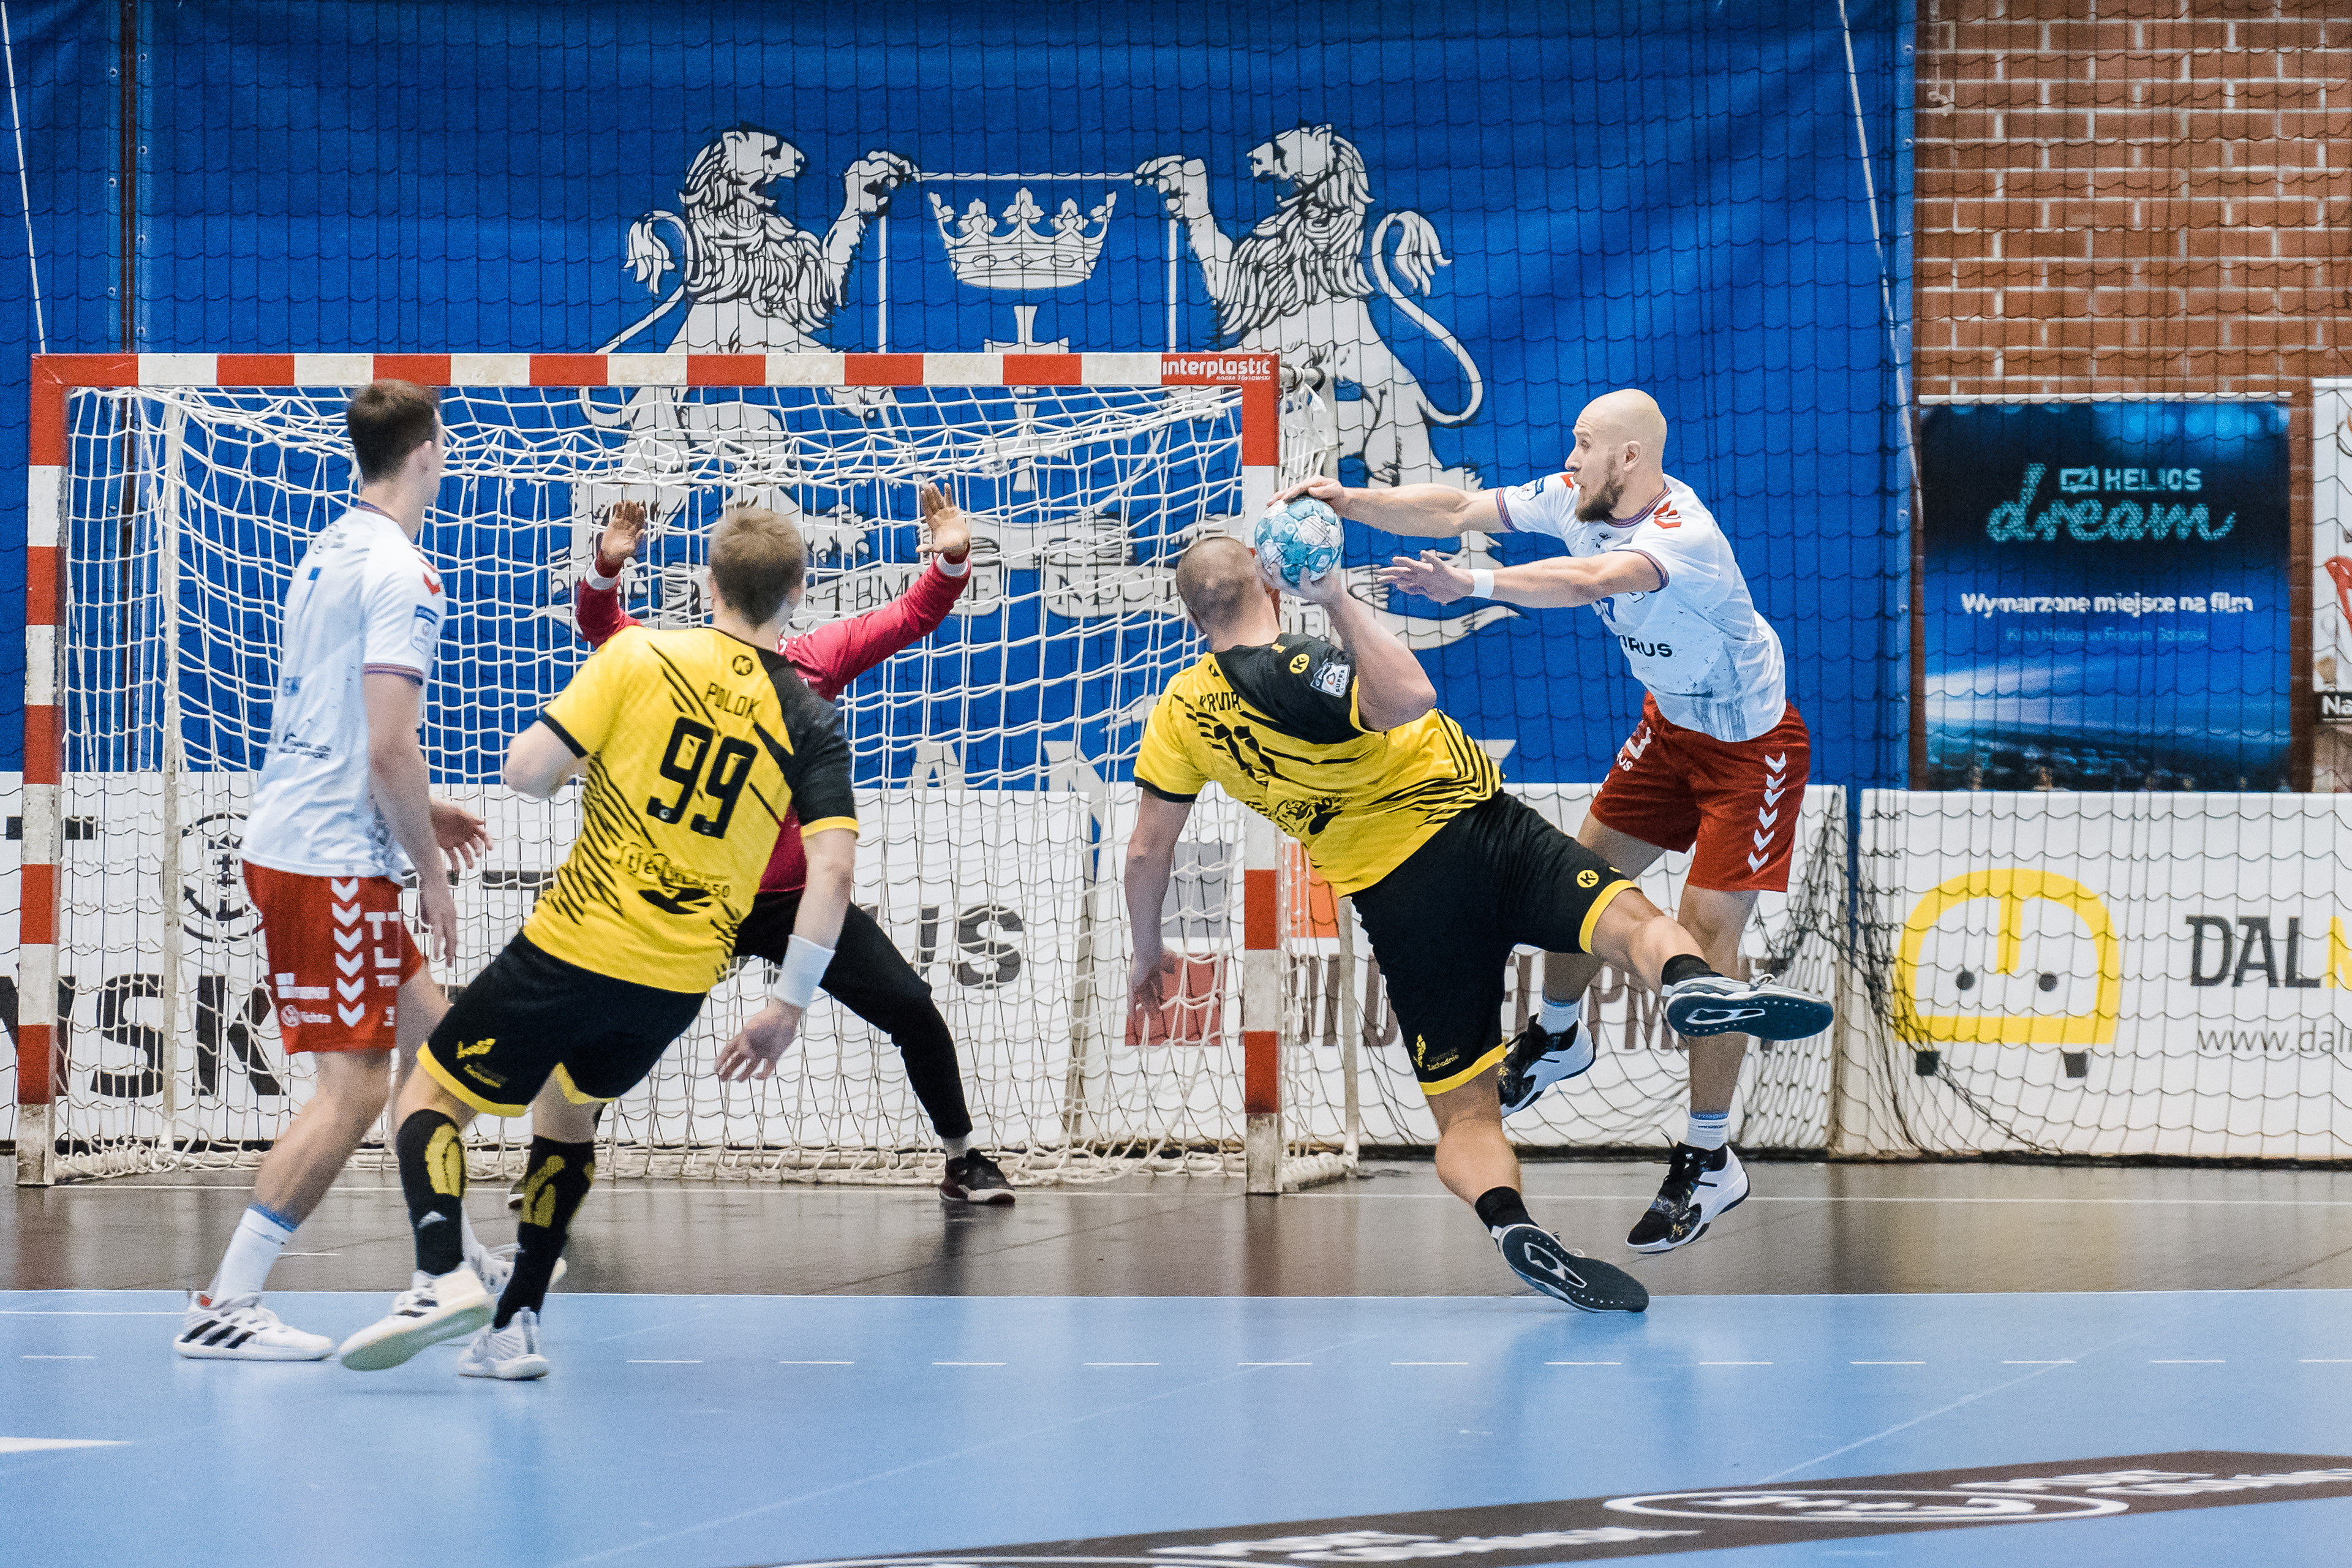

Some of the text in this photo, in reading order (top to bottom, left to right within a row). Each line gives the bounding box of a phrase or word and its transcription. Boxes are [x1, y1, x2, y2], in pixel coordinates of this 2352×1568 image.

[1163, 358, 1270, 378] interplastic
[2103, 468, 2202, 491] HELIOS
[1986, 463, 2236, 542] dream
[1961, 592, 2254, 619] Wymarzone miejsce na film
[646, 716, 758, 839] 99
[2198, 1022, 2352, 1052] www.dal
